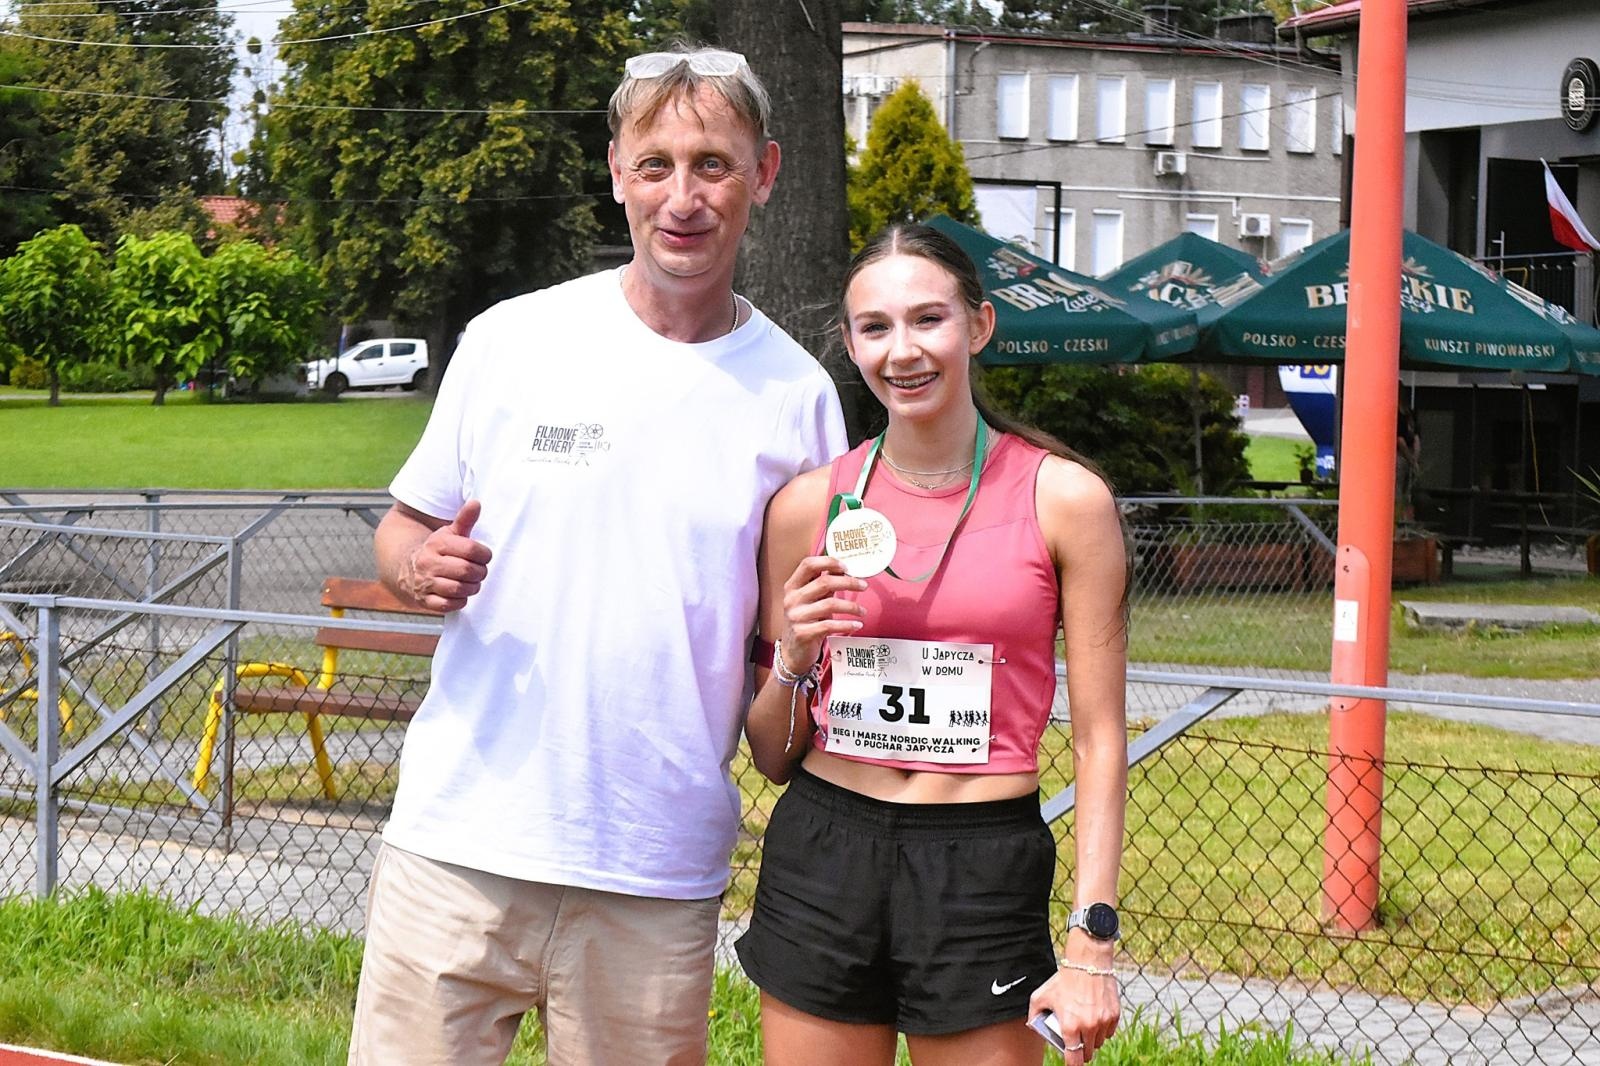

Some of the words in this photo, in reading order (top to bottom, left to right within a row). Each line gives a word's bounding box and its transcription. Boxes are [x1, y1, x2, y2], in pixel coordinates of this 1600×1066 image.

[997, 340, 1048, 354] POLSKO
[1064, 338, 1109, 352] CZESKI
[1243, 332, 1296, 347] POLSKO
[1314, 335, 1347, 348] CZES
[1424, 338, 1470, 354] KUNSZT
[1475, 342, 1555, 358] PIWOWARSKI
[535, 425, 578, 441] FILMOWE
[531, 438, 575, 454] PLENERY
[833, 528, 866, 541] FILMOWE
[835, 538, 868, 552] PLENERY
[846, 647, 875, 659] FILMOWE
[922, 647, 929, 660] U
[848, 657, 875, 669] PLENERY
[922, 666, 932, 675] W
[878, 684, 930, 725] 31
[832, 727, 851, 738] BIEG
[857, 731, 887, 742] MARSZ
[890, 733, 928, 745] NORDIC
[932, 737, 980, 746] WALKING
[863, 739, 902, 751] PUCHAR
[905, 744, 954, 754] JAPYCZA
